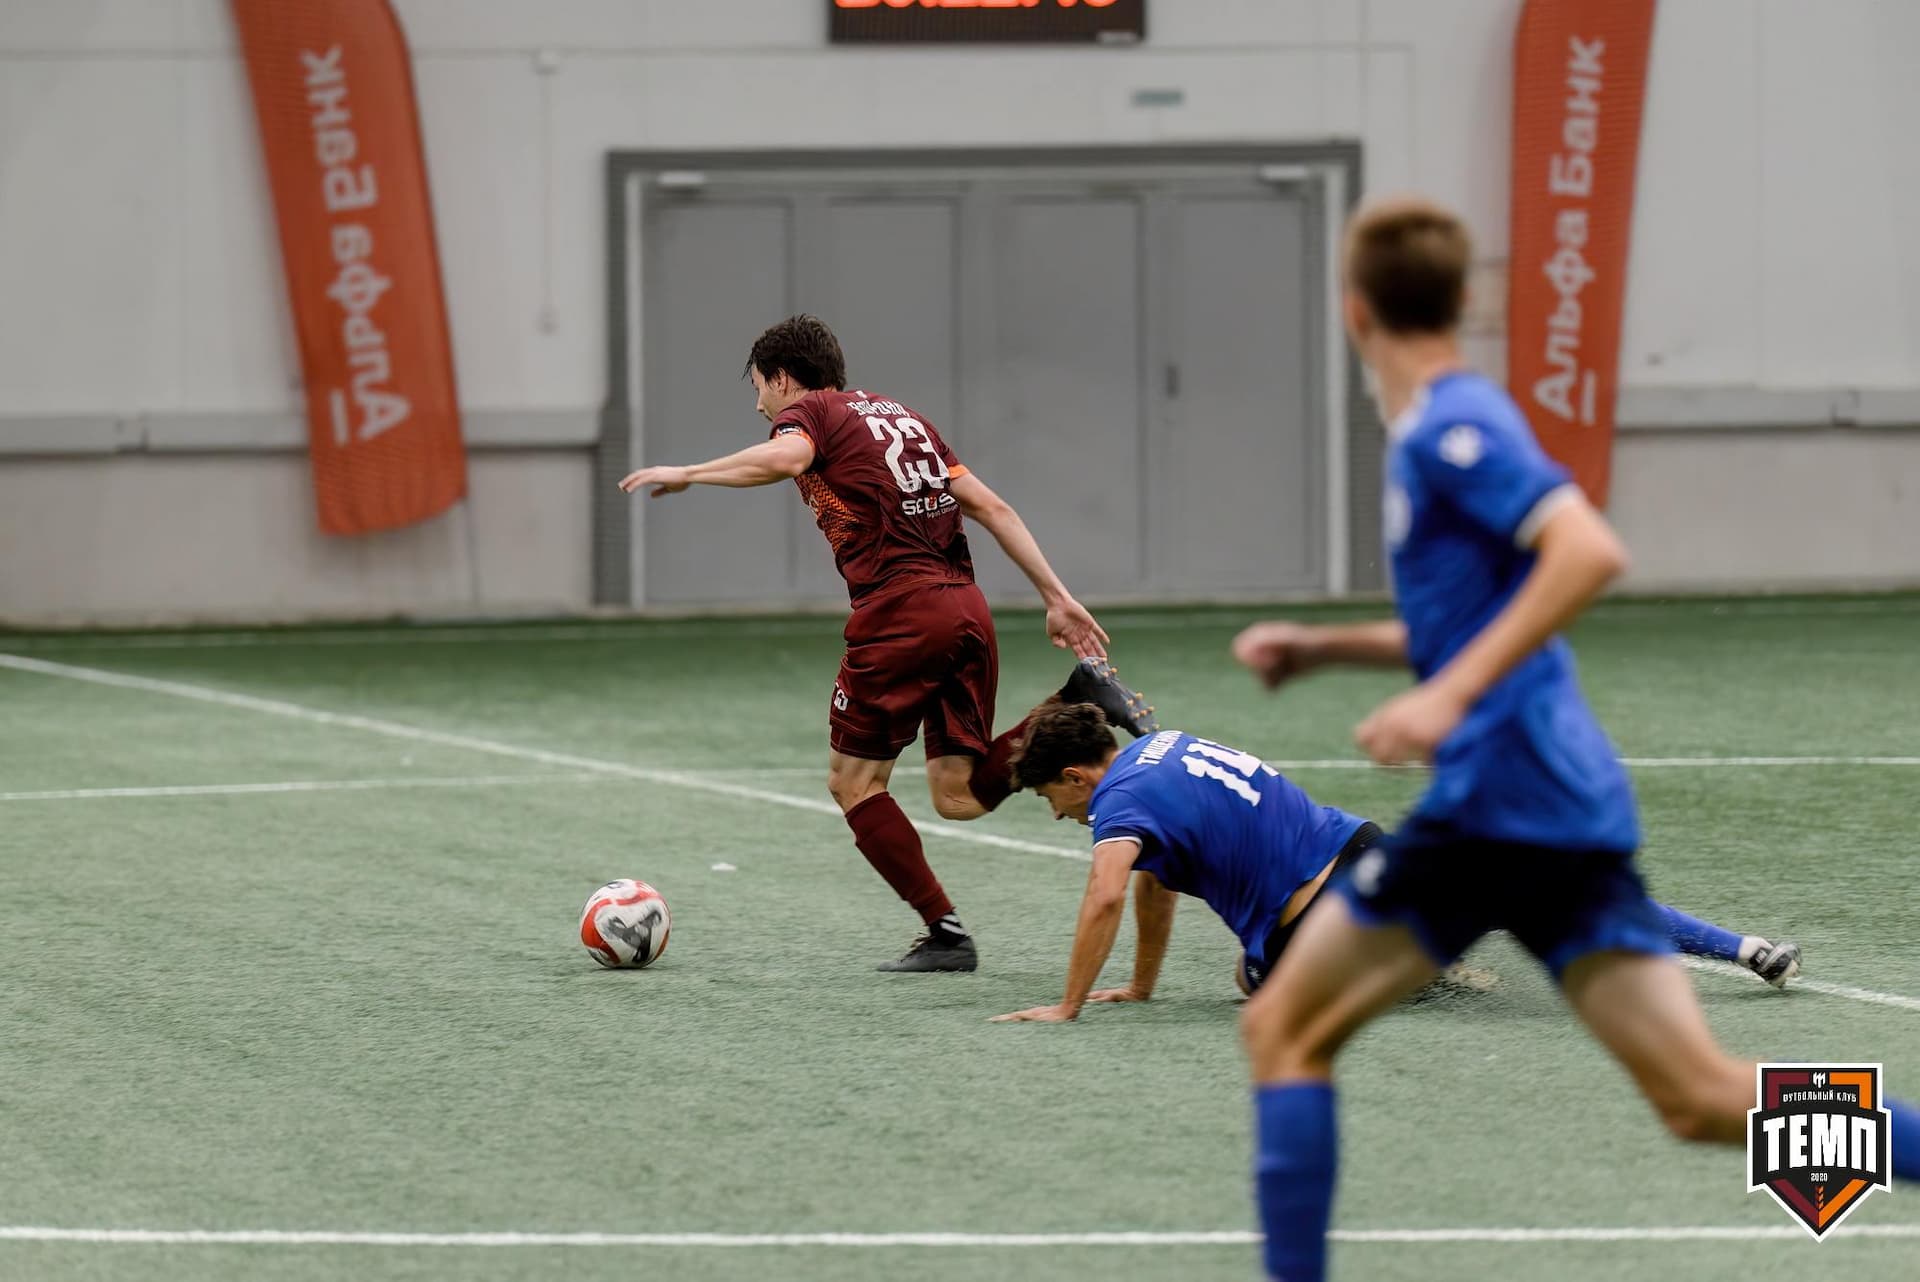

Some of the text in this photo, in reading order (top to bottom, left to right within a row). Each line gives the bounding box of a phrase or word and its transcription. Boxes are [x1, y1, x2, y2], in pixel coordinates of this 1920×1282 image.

[1534, 36, 1605, 421] Альфа Банк
[865, 415, 950, 494] 23
